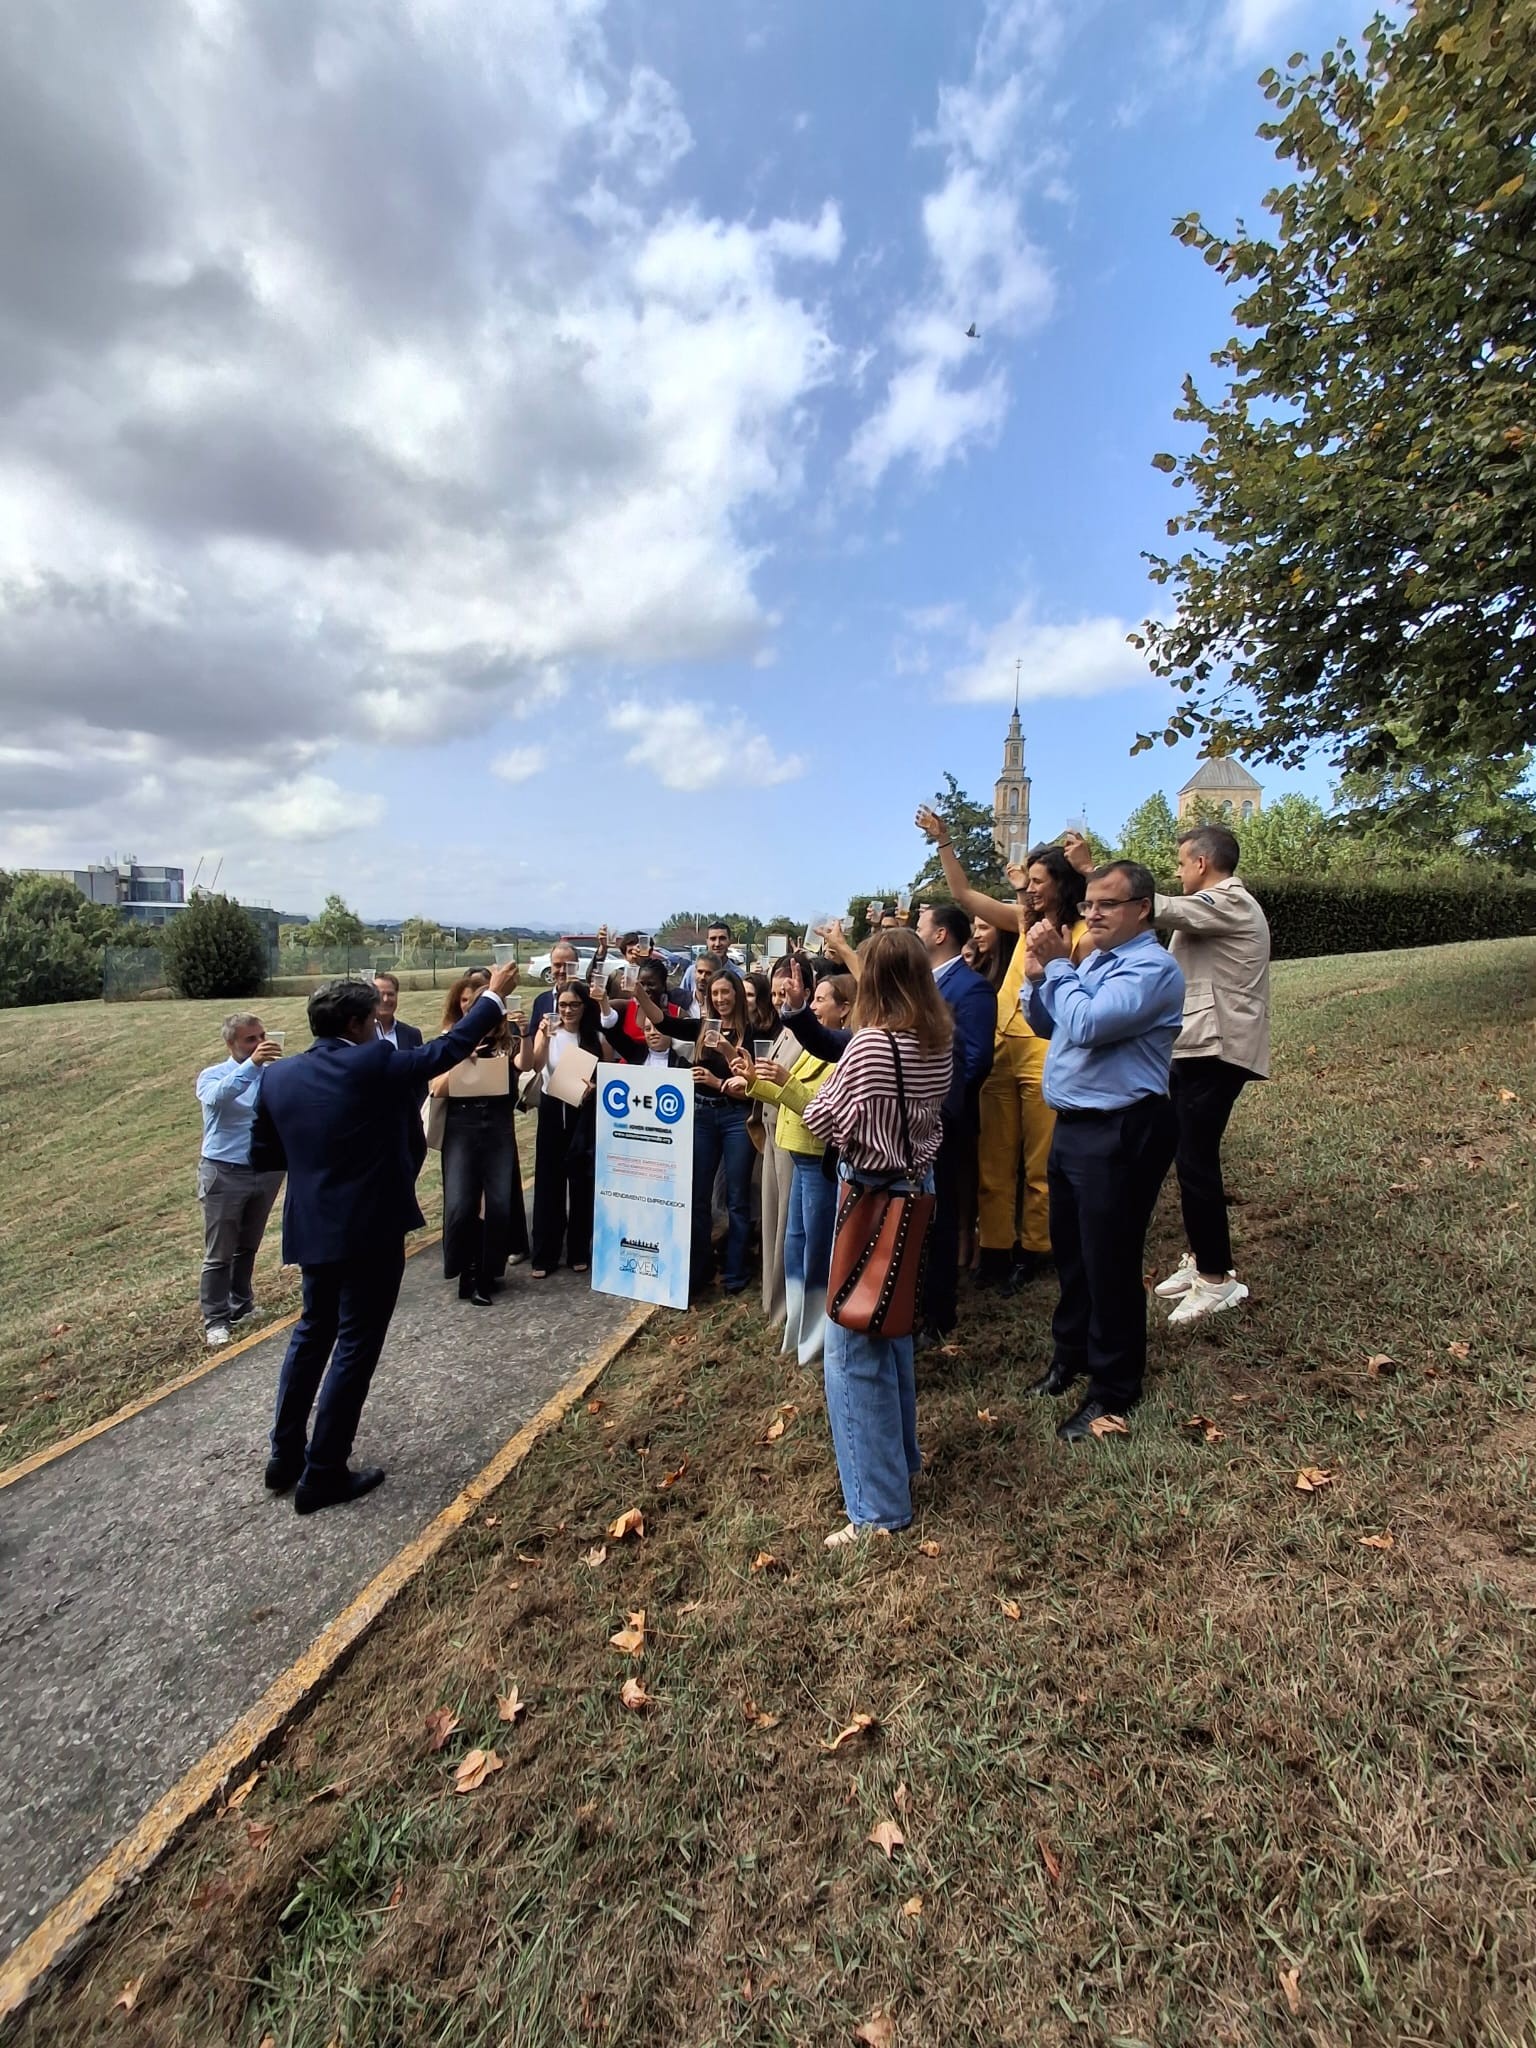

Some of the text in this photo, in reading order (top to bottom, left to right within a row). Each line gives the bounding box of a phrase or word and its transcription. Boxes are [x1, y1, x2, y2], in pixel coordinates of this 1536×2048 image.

[608, 1087, 626, 1110] C
[613, 1192, 646, 1202] RENDIMIENTO
[647, 1197, 685, 1208] EMPRENDEDOR
[623, 1258, 659, 1274] JOVEN
